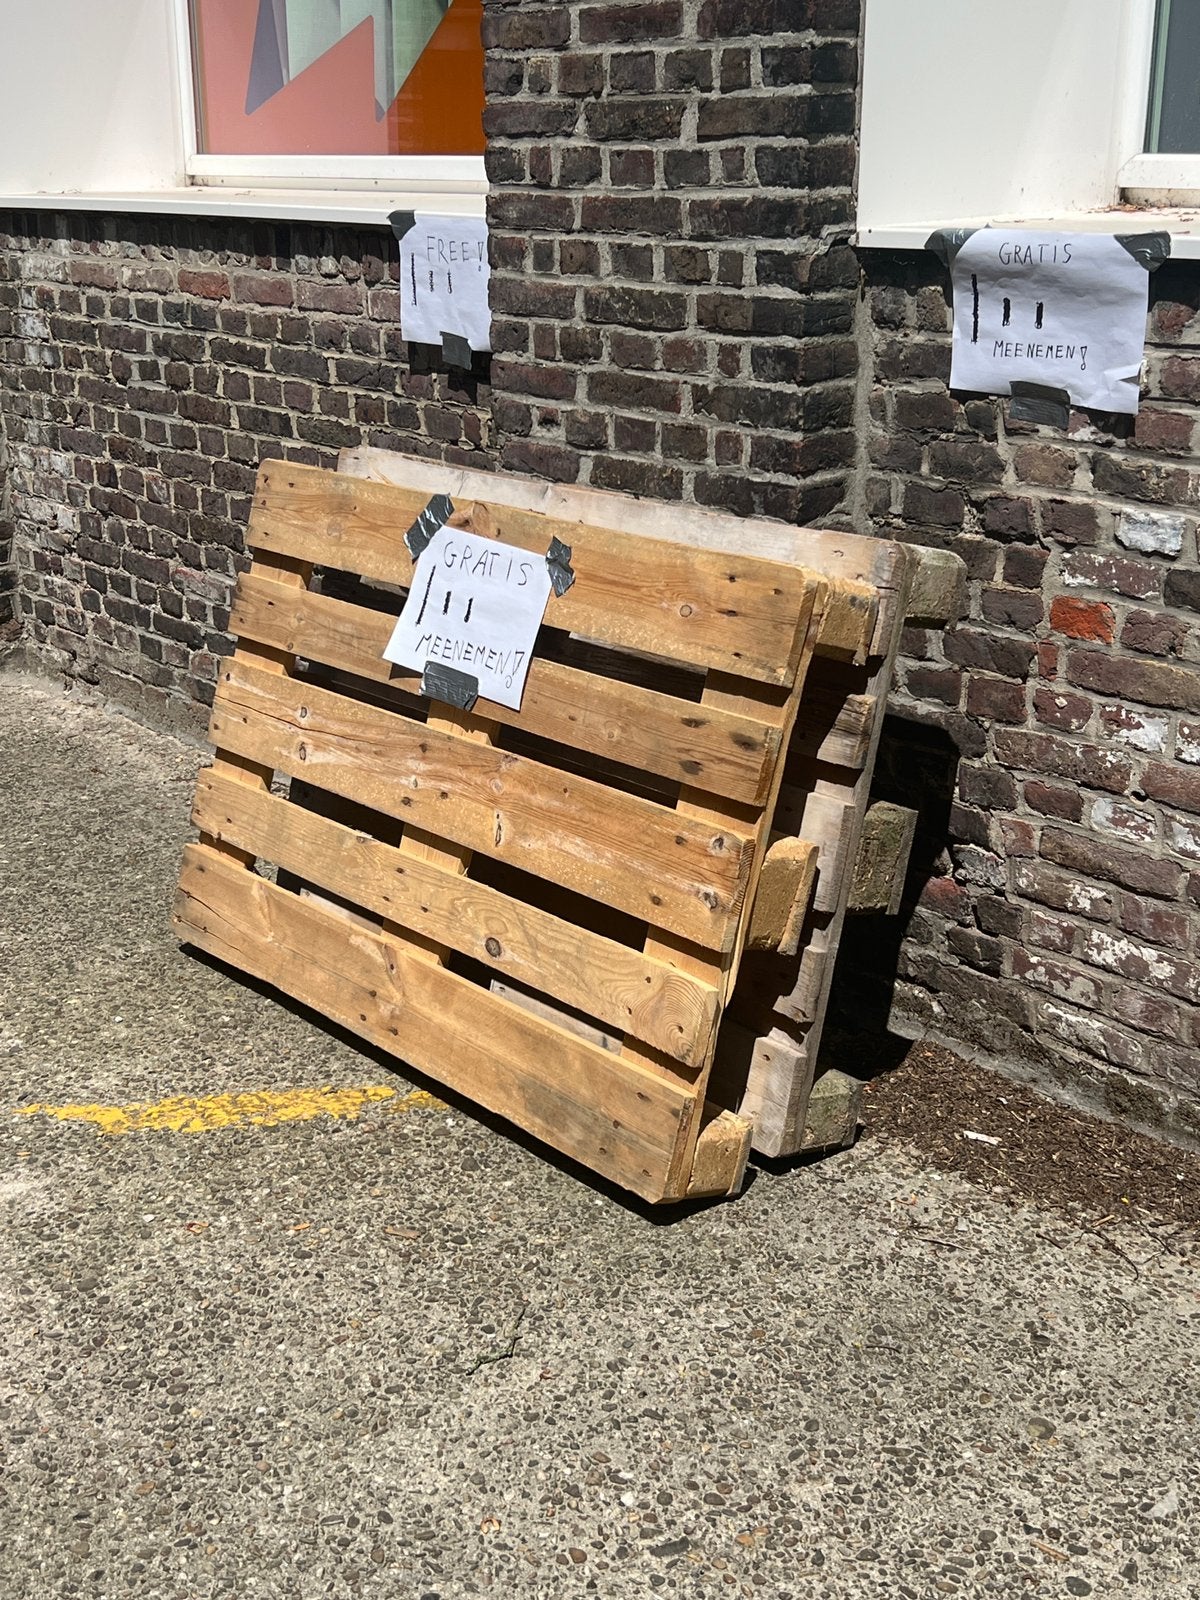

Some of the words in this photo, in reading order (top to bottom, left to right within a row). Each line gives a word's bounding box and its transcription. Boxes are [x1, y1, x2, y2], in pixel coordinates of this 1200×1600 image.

[998, 242, 1072, 265] GRATIS
[993, 340, 1087, 371] MEENEMEN!
[443, 541, 533, 586] GRATIS
[415, 633, 525, 689] MEENEMEN!
